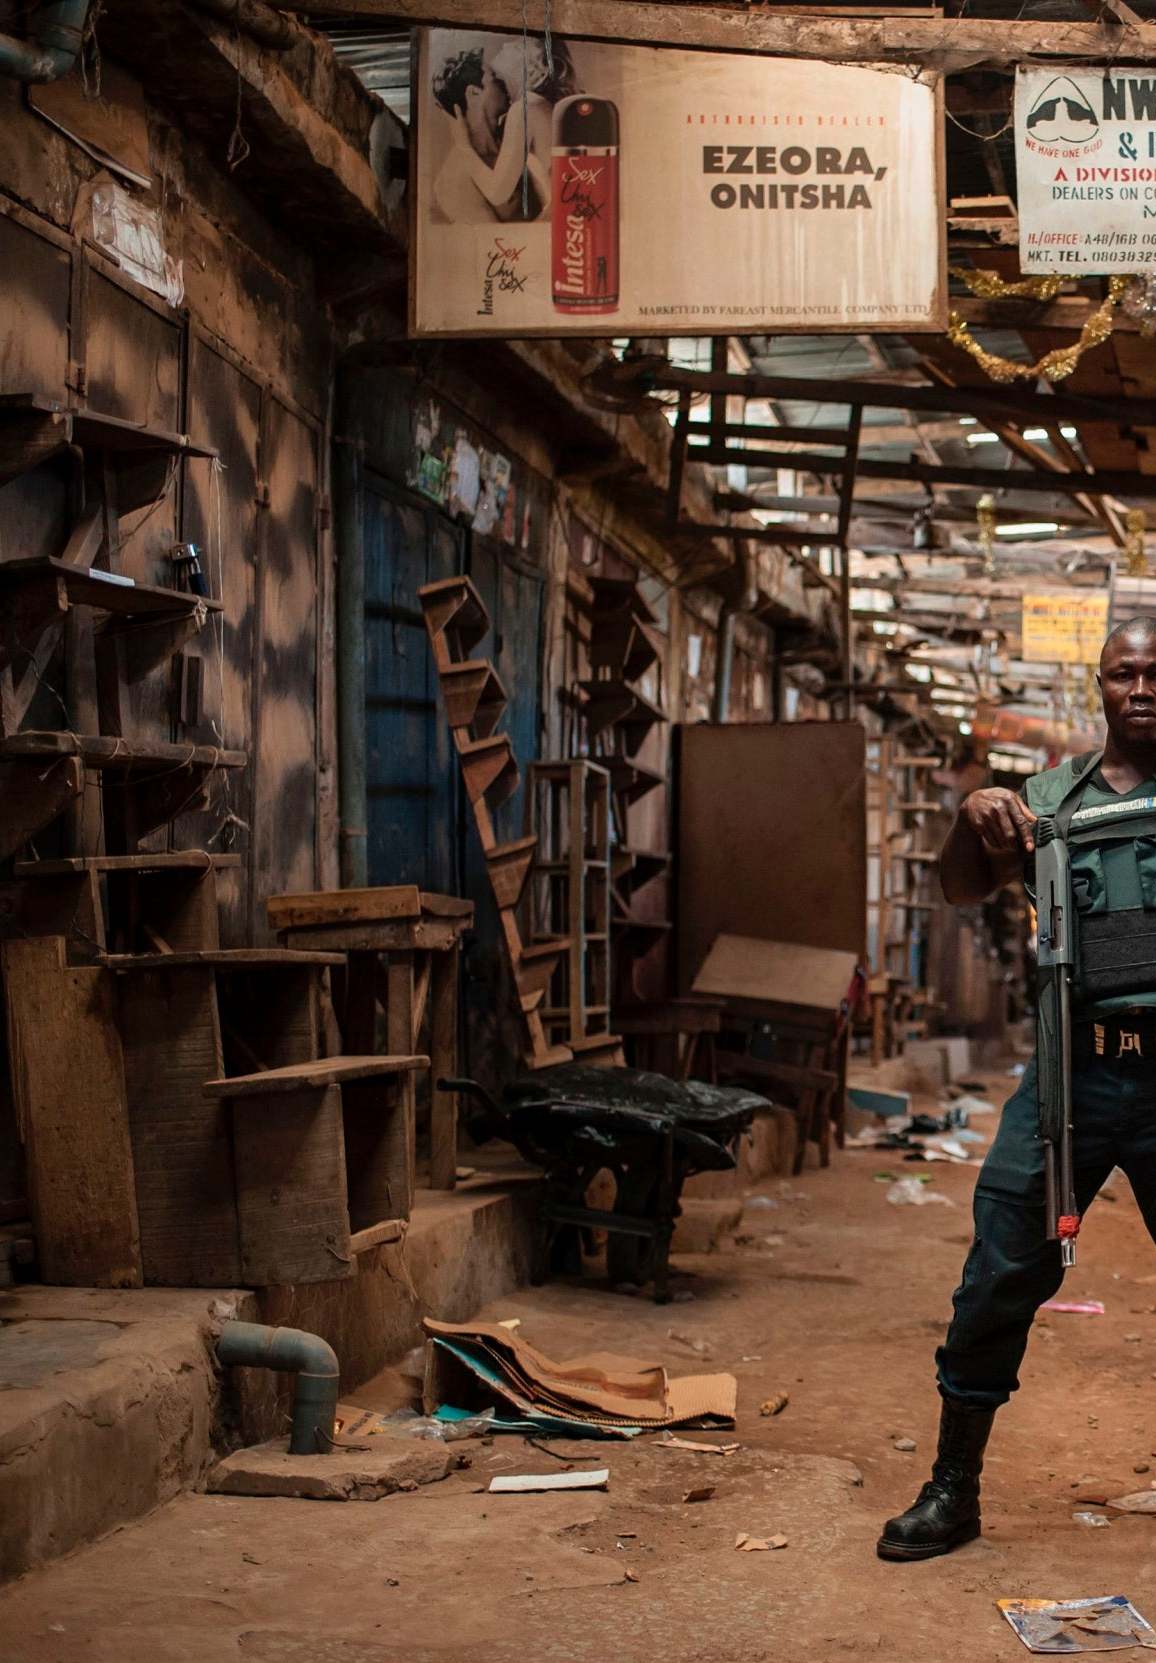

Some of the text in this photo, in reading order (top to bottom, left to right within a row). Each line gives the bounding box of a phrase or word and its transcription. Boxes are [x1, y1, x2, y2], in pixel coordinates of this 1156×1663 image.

[1038, 145, 1059, 158] HAVE
[1062, 148, 1081, 158] ONE
[1083, 139, 1103, 154] GOD
[1118, 131, 1138, 161] &
[702, 145, 887, 182] EZEORA,
[1054, 167, 1069, 183] A
[710, 183, 873, 210] ONITSHA
[1052, 186, 1114, 201] DEALERS
[1119, 186, 1139, 201] ON
[554, 213, 584, 295] Intesa
[1027, 251, 1053, 263] MKT.
[1058, 250, 1087, 262] TEL.
[476, 280, 493, 316] Intesa
[638, 306, 700, 316] MARKETED
[702, 305, 718, 315] BY
[719, 305, 766, 315] FAREAST
[771, 305, 841, 315] MERCANTILE
[844, 304, 899, 315] COMPANY
